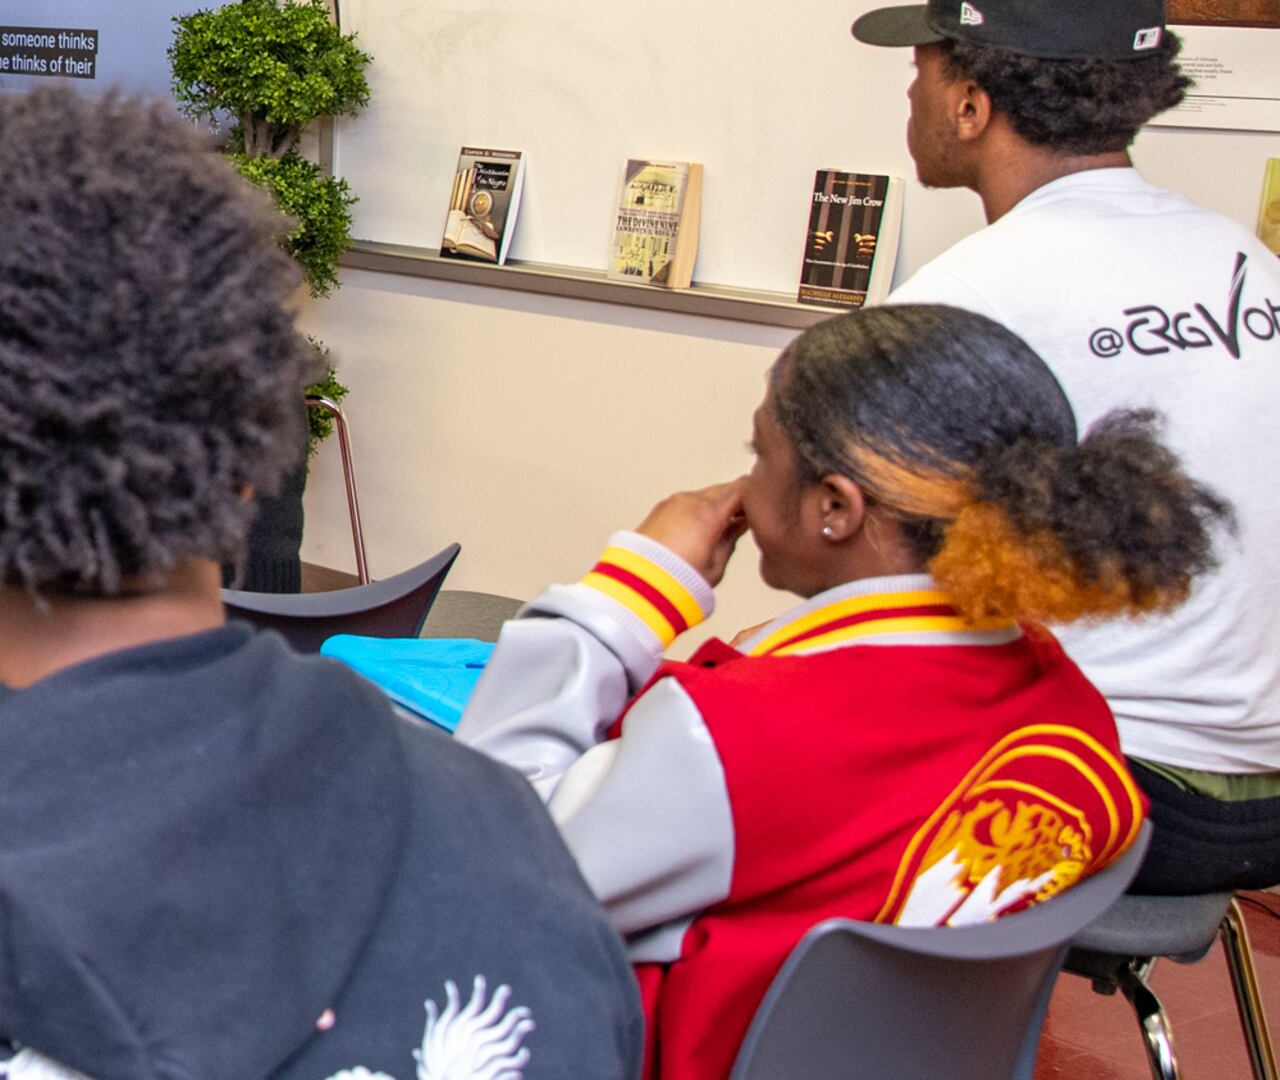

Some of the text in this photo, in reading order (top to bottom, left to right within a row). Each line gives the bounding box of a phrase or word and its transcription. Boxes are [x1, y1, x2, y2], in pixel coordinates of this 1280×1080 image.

[2, 33, 55, 48] someone
[58, 32, 94, 50] thinks
[12, 55, 47, 72] thinks
[49, 56, 63, 73] of
[65, 57, 93, 75] their
[814, 192, 883, 207] The New Jim Crow
